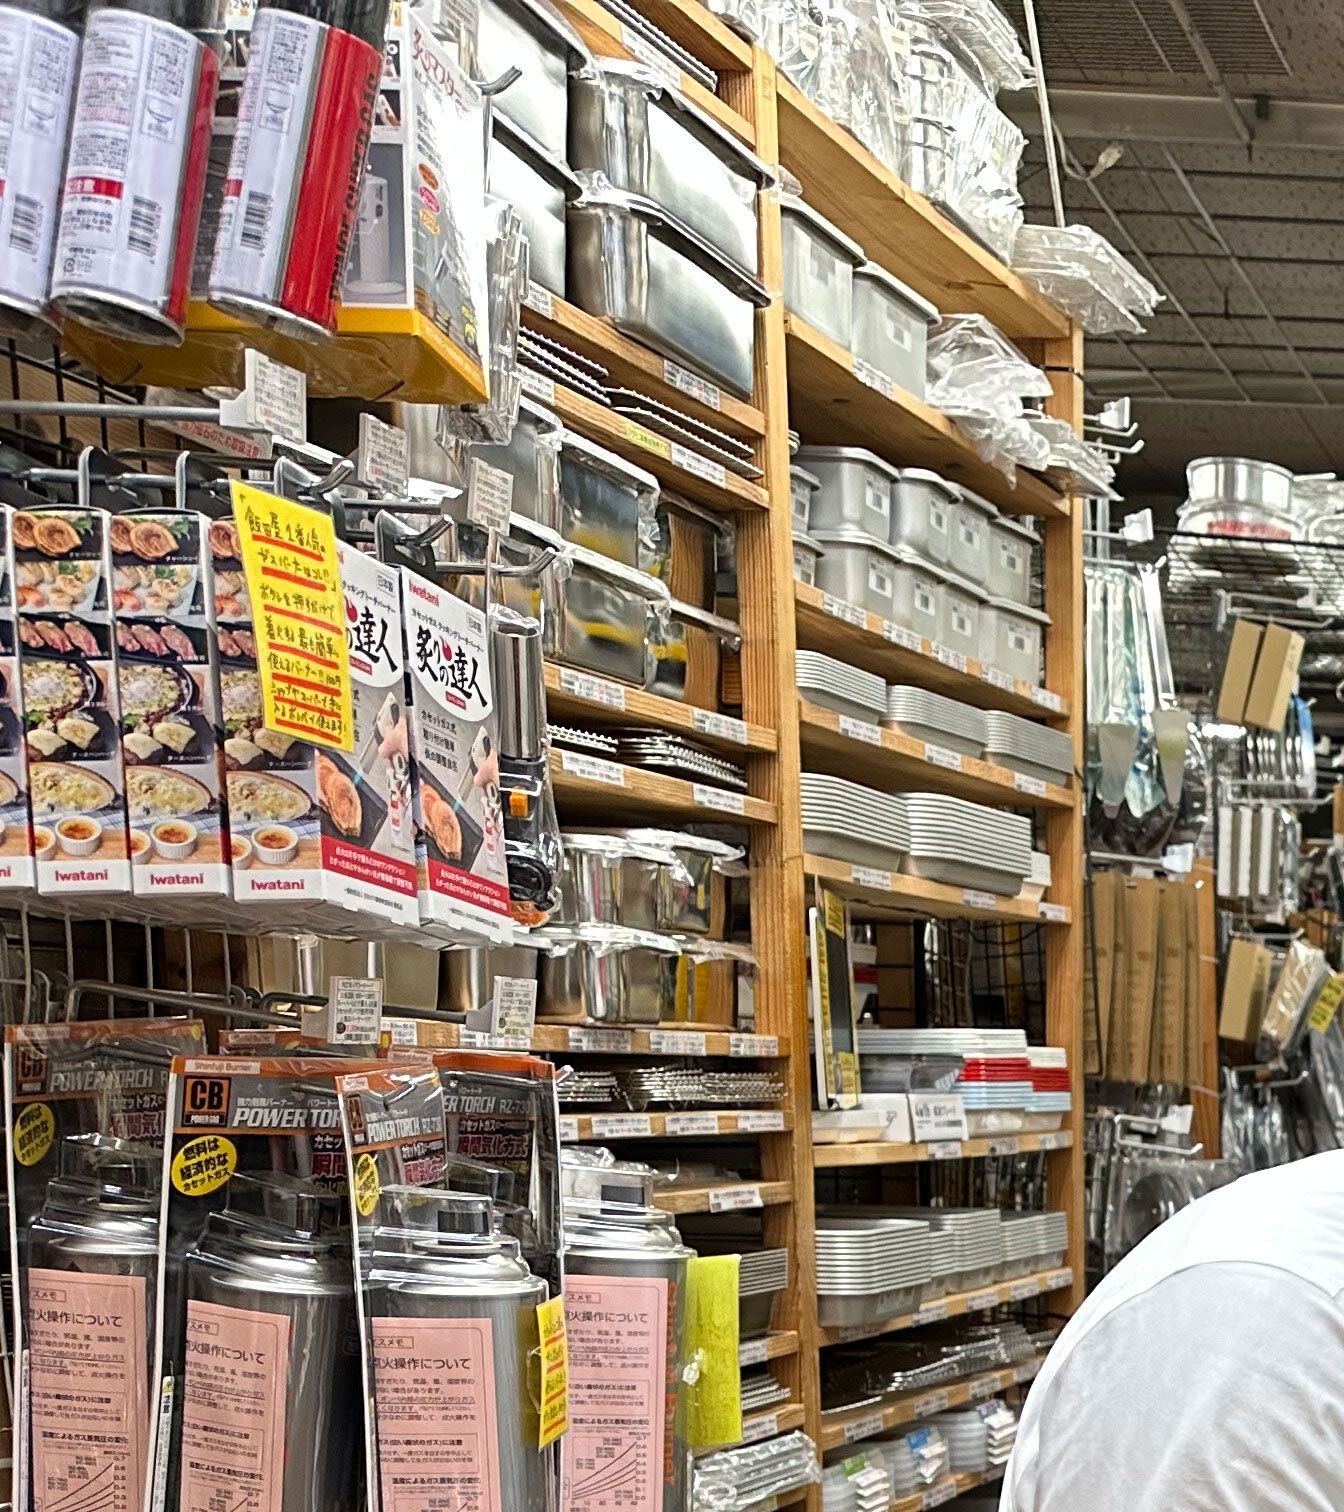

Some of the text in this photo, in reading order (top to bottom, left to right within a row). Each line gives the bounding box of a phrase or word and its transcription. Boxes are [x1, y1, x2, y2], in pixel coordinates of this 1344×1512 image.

[409, 581, 440, 606] Iwatani
[54, 867, 109, 883] Iwatani
[149, 872, 205, 887] Iwatani
[250, 878, 306, 893] Iwatani
[190, 1079, 225, 1110] CB
[457, 1095, 496, 1114] TORCH
[233, 1107, 308, 1129] POWER
[367, 1118, 396, 1144] POWER
